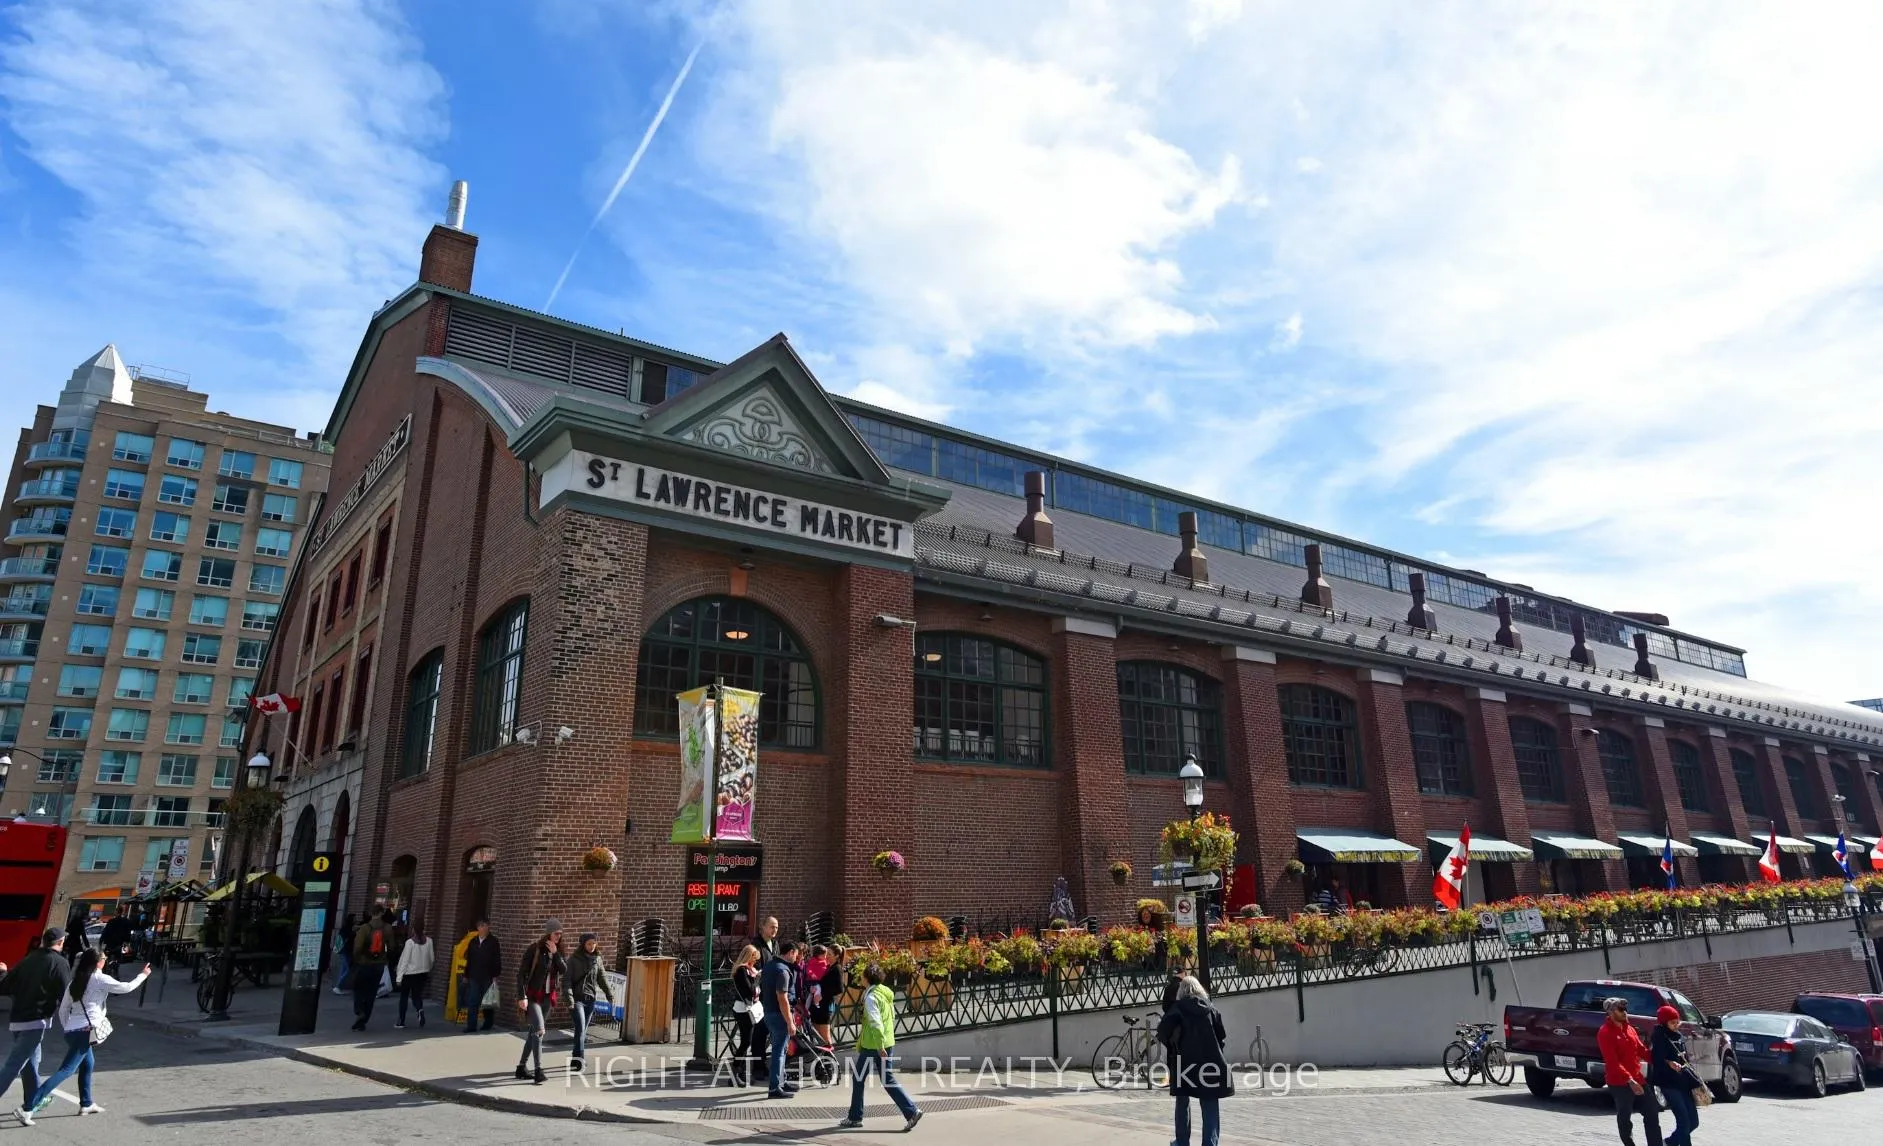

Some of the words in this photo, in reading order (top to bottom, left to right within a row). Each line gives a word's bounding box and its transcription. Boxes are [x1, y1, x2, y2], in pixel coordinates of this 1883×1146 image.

[634, 467, 787, 528] LAWRENCE
[799, 506, 903, 549] MARKET
[687, 883, 741, 896] RESTURANT
[687, 899, 707, 911] OPE
